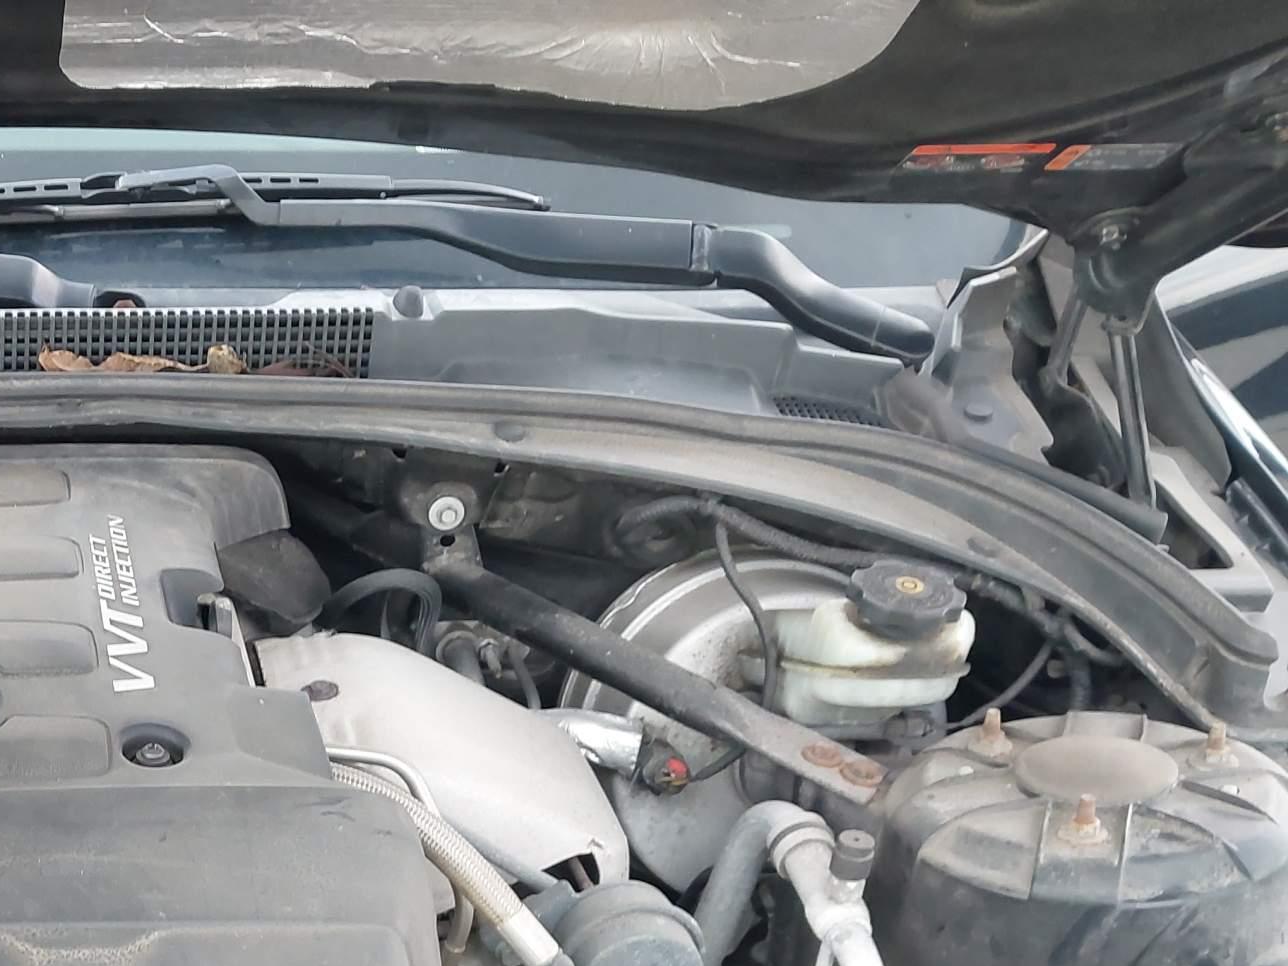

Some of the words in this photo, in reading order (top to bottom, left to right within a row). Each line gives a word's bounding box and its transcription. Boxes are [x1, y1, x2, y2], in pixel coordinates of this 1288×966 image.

[89, 533, 116, 600] DIRECT
[107, 513, 140, 607] INJECTION
[99, 598, 155, 692] VVT
